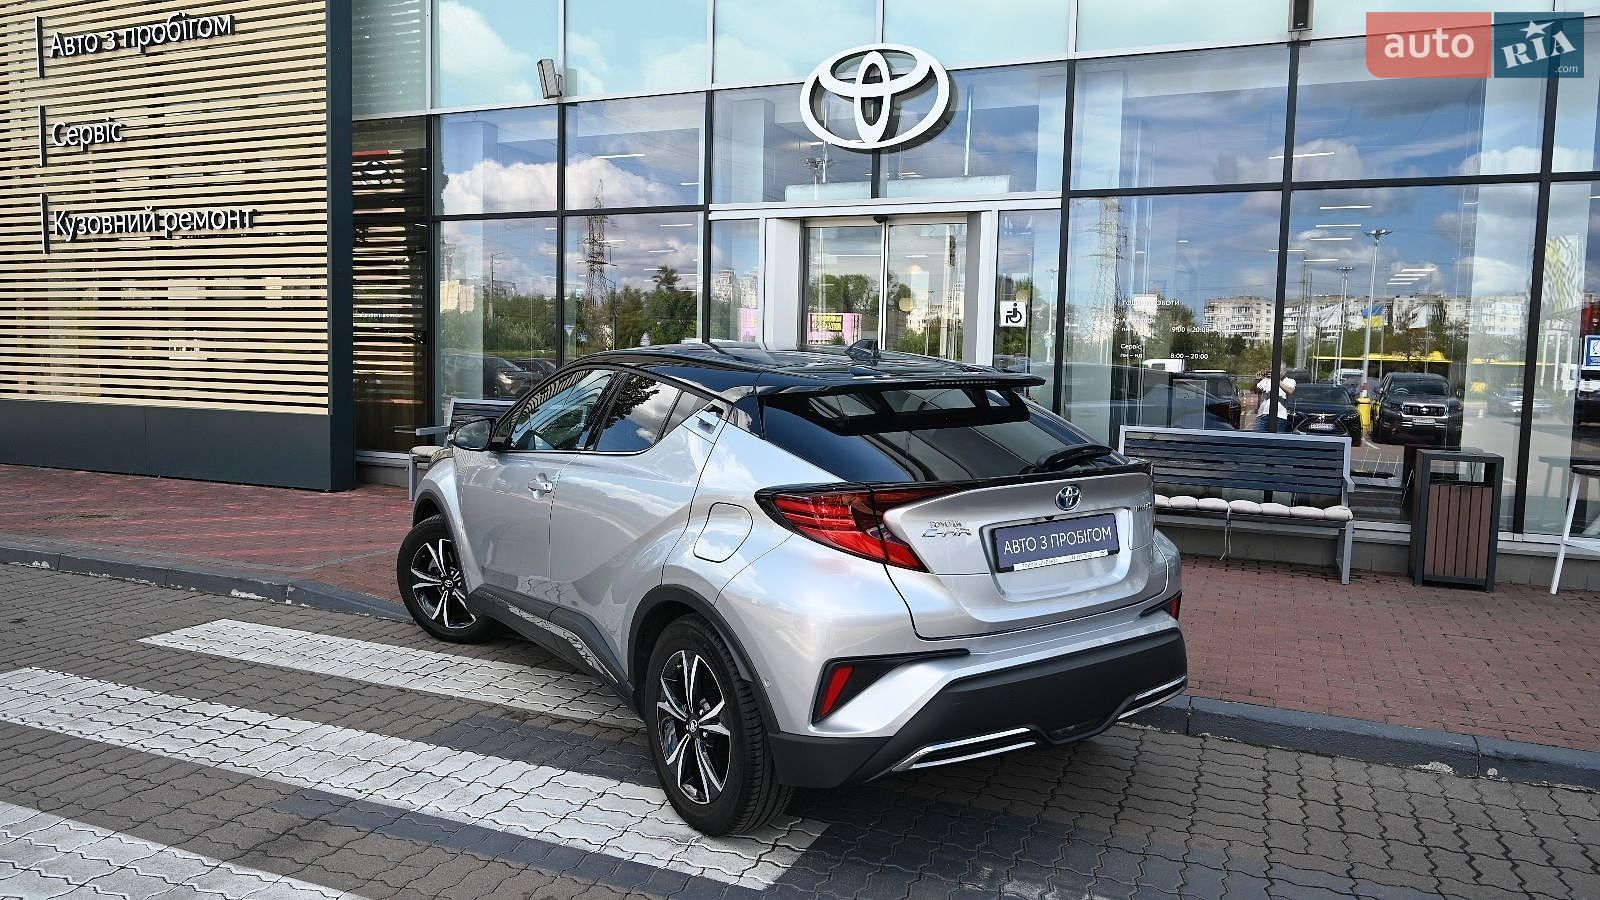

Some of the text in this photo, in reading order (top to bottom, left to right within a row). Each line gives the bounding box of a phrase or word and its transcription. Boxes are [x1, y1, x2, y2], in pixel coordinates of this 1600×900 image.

[50, 12, 233, 57] Авто з пробігом
[52, 117, 123, 151] Сервіс
[54, 206, 254, 242] Кузовний ремонт
[1003, 536, 1037, 555] АВТО
[1050, 526, 1112, 548] ПРОБІГОМ
